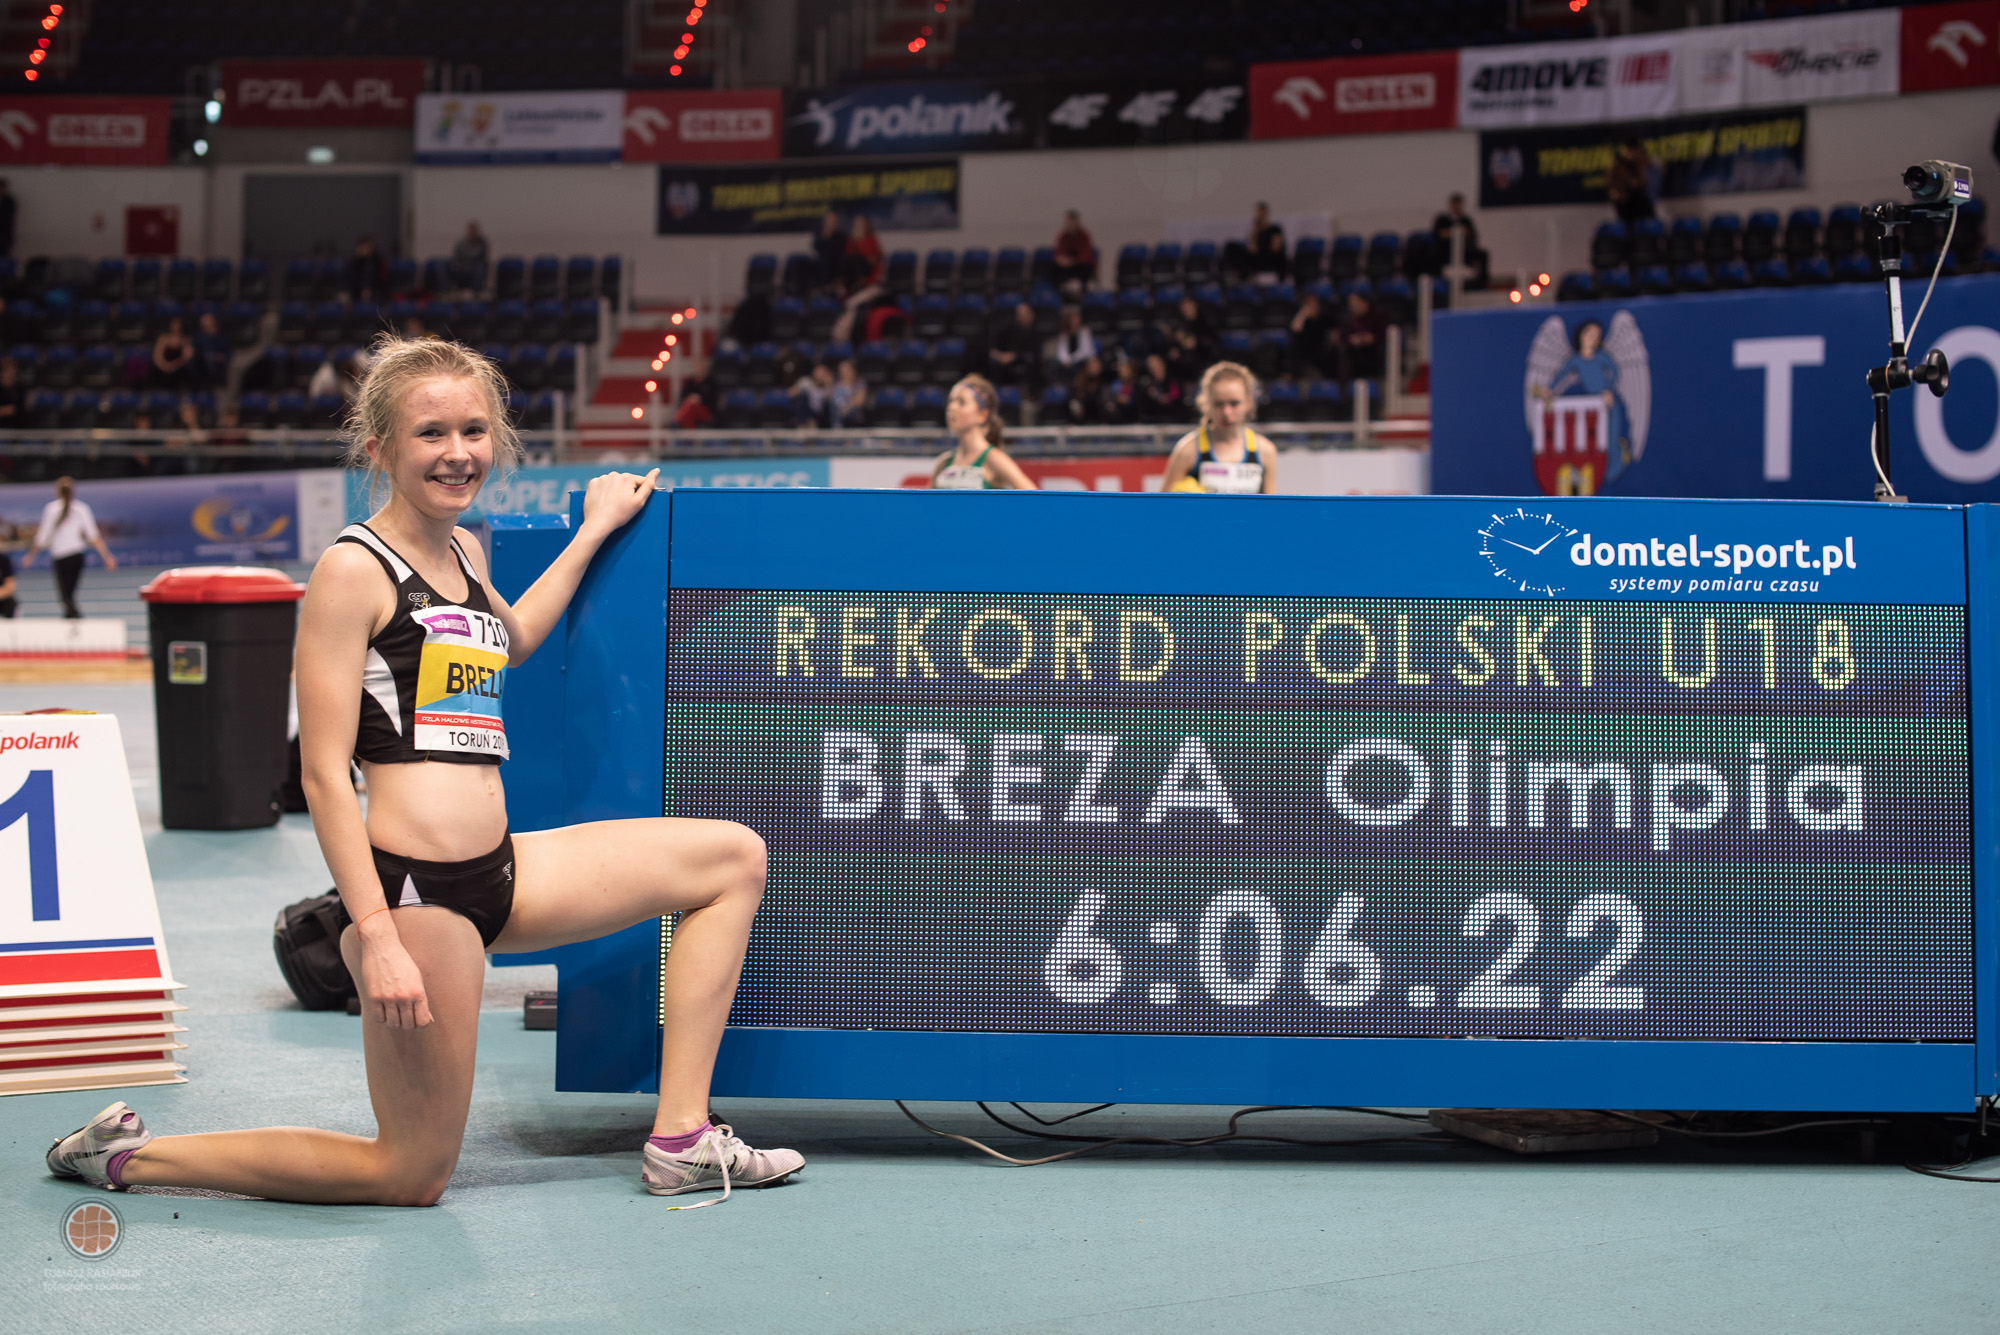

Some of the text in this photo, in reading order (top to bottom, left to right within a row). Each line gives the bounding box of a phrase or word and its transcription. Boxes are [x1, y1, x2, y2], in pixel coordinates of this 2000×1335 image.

[1472, 56, 1608, 93] 4MOVE
[846, 92, 1014, 149] polanik
[1570, 533, 1857, 576] domtel-sport.pl
[1609, 576, 1819, 594] systemy pomiaru czasu
[775, 606, 1857, 690] REKORD POLSKI U18
[0, 731, 80, 754] polanik
[449, 730, 490, 748] TORUŃ
[822, 731, 1863, 850] BREZA Olimpia
[0, 769, 60, 921] 1
[1044, 888, 1644, 1009] 6:06.22
